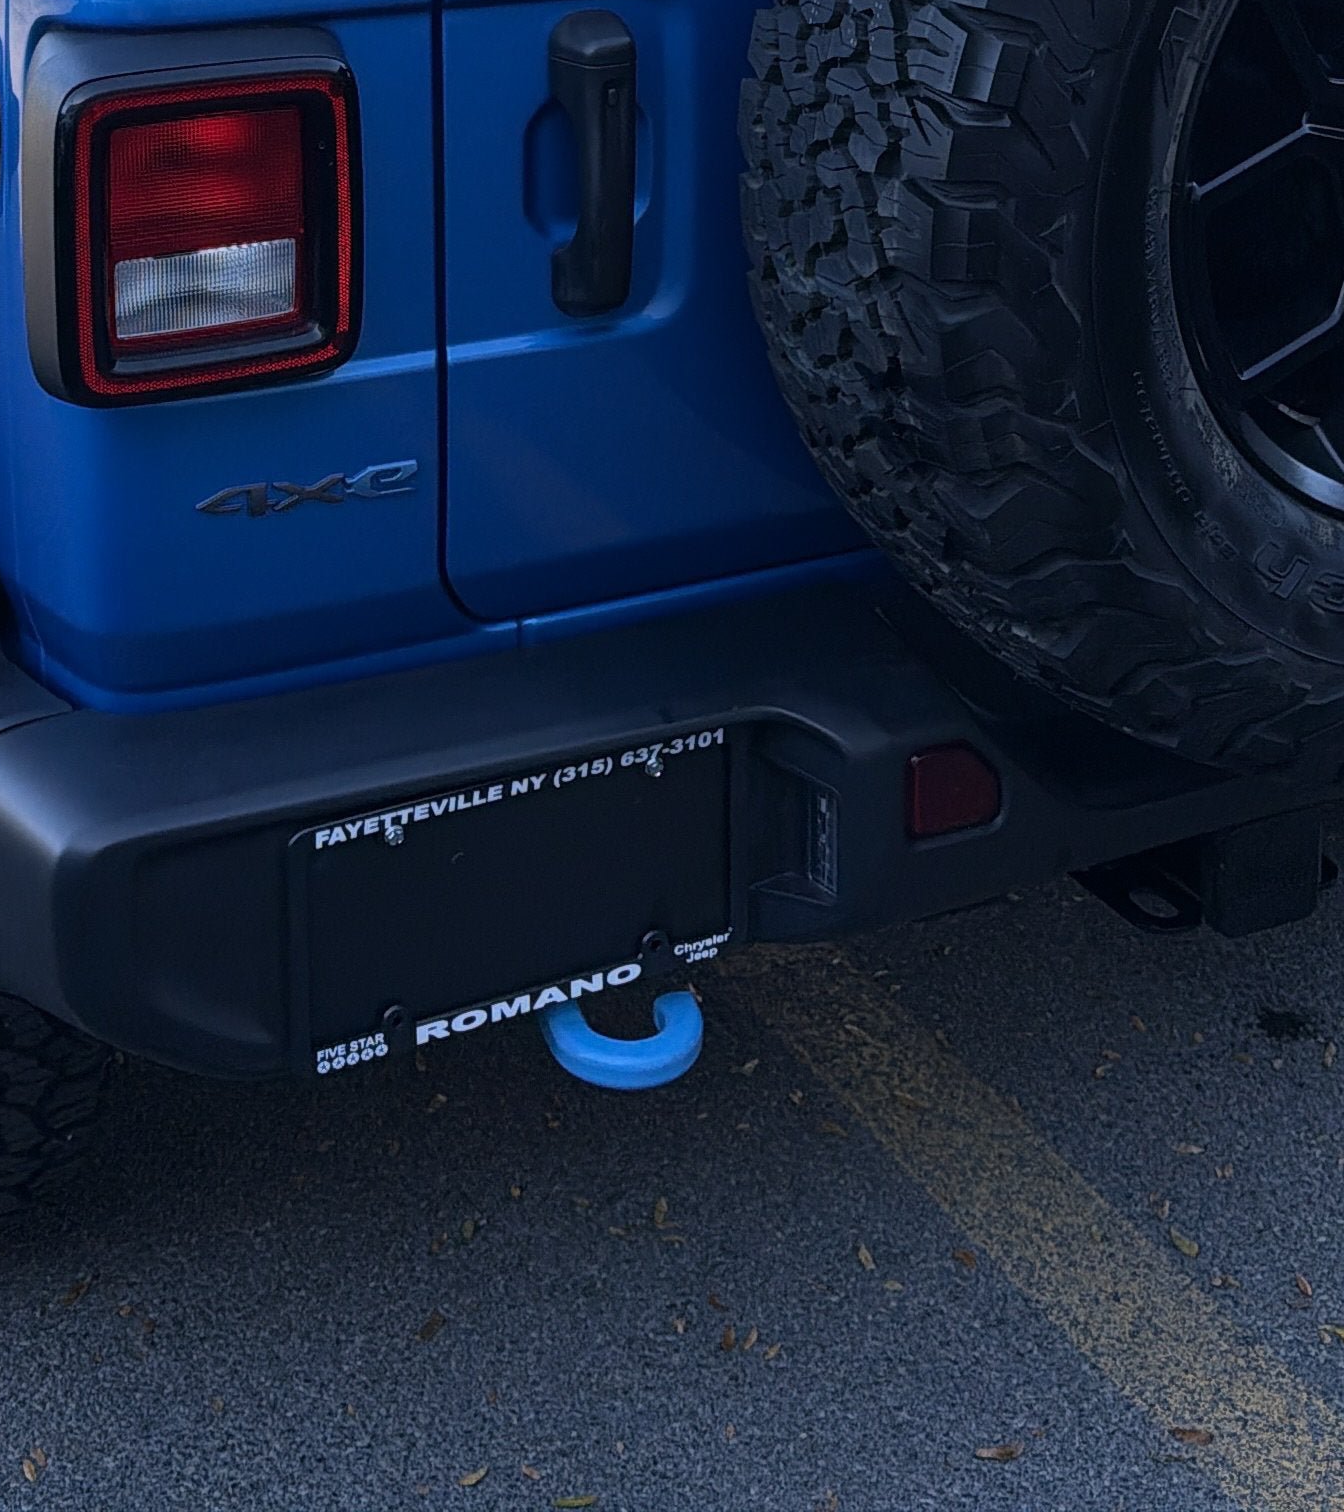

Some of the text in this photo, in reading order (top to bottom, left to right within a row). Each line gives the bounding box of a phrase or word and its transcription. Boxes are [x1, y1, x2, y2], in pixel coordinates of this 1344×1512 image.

[315, 727, 724, 850] FAYETTEVILLE NY (315) 637-3101
[673, 932, 730, 955] Chrysler
[686, 947, 718, 963] Jeep
[416, 963, 641, 1046] ROMANO
[317, 1033, 384, 1062] FIVE STAR
